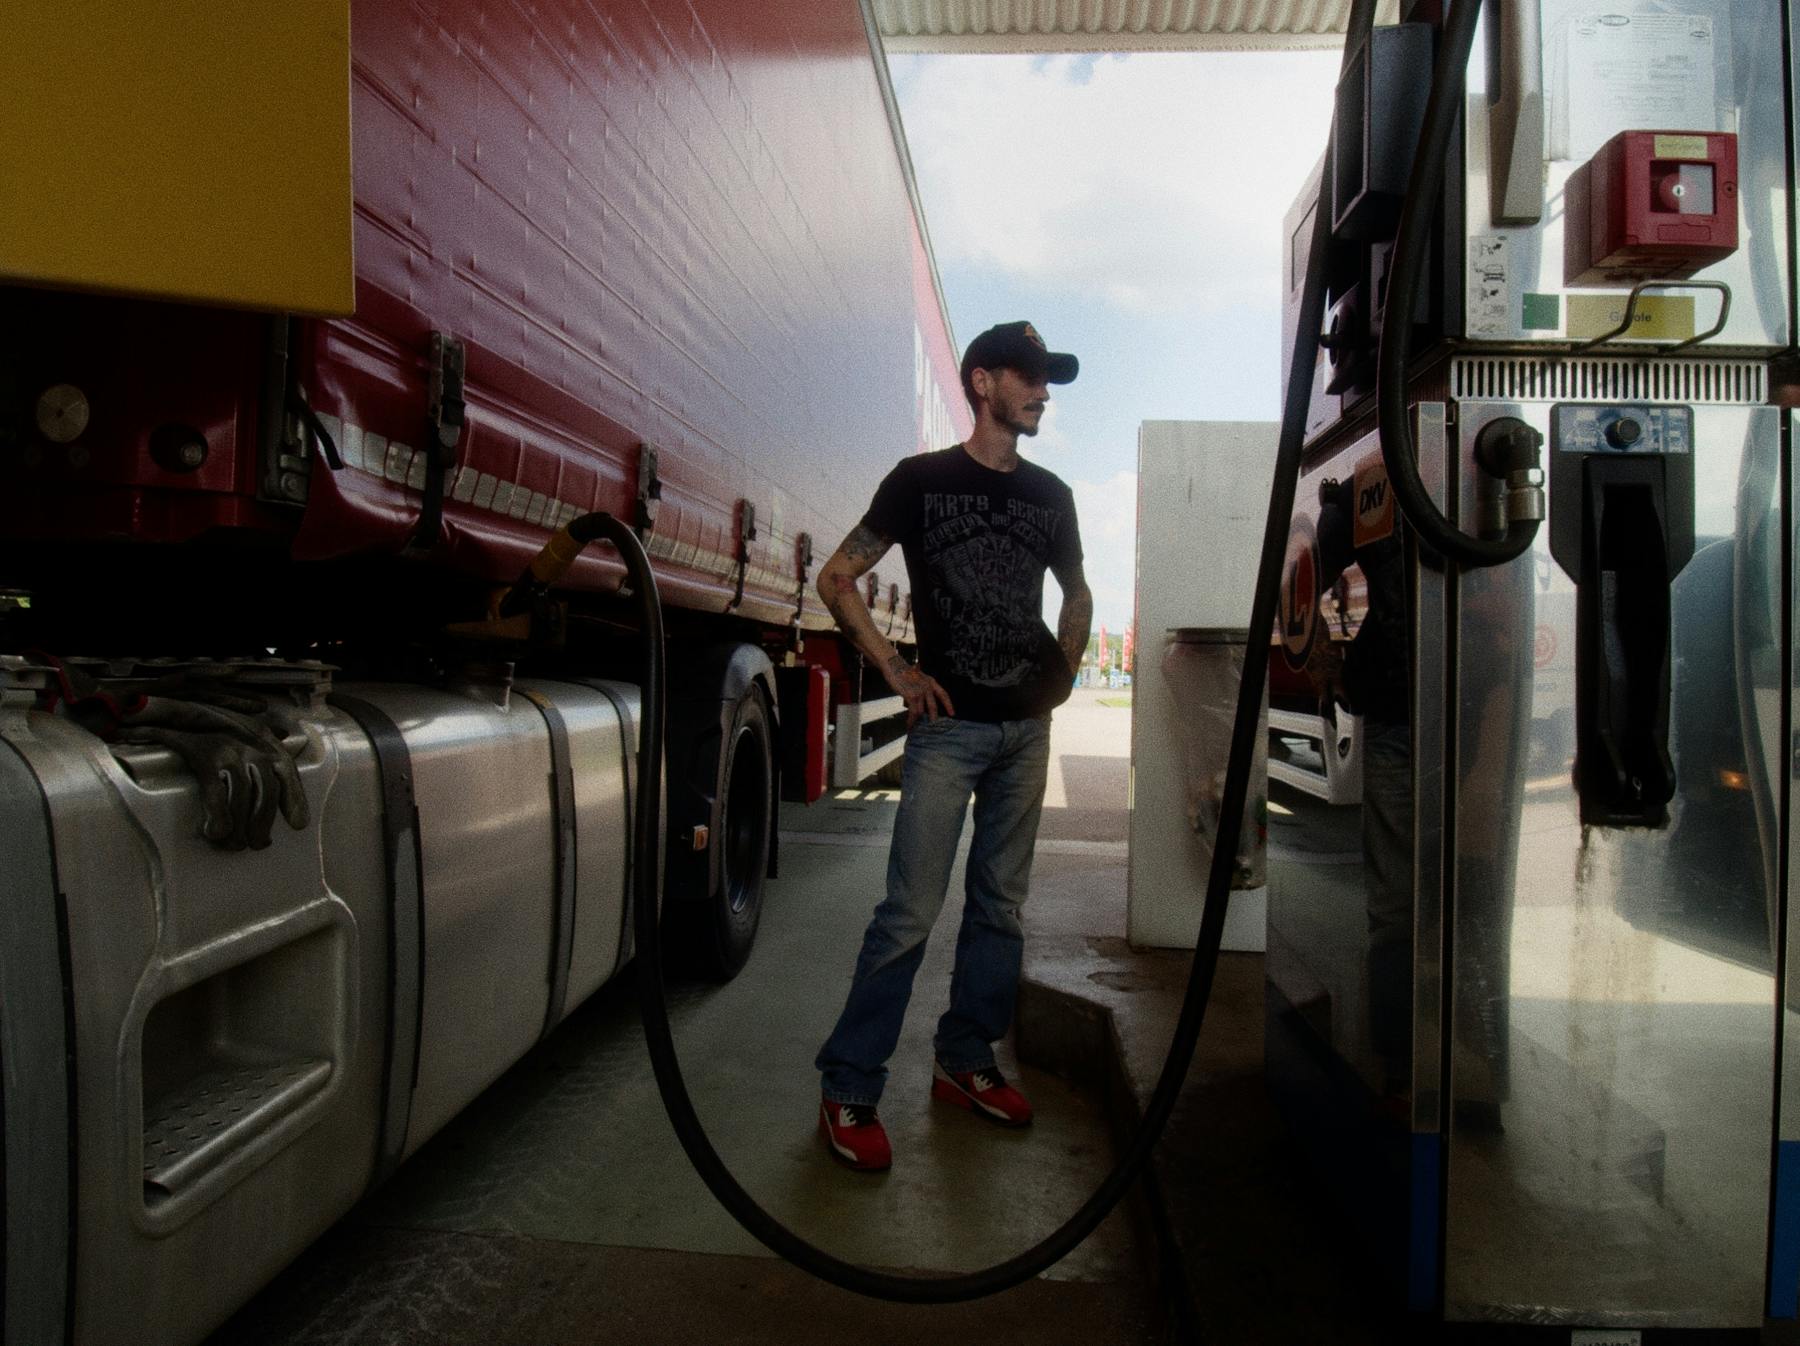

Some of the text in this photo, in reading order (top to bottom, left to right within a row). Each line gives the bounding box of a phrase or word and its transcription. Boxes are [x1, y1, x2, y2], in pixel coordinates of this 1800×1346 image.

[1609, 311, 1652, 322] Gaole
[923, 492, 990, 528] PARTS
[1360, 478, 1387, 516] DKV
